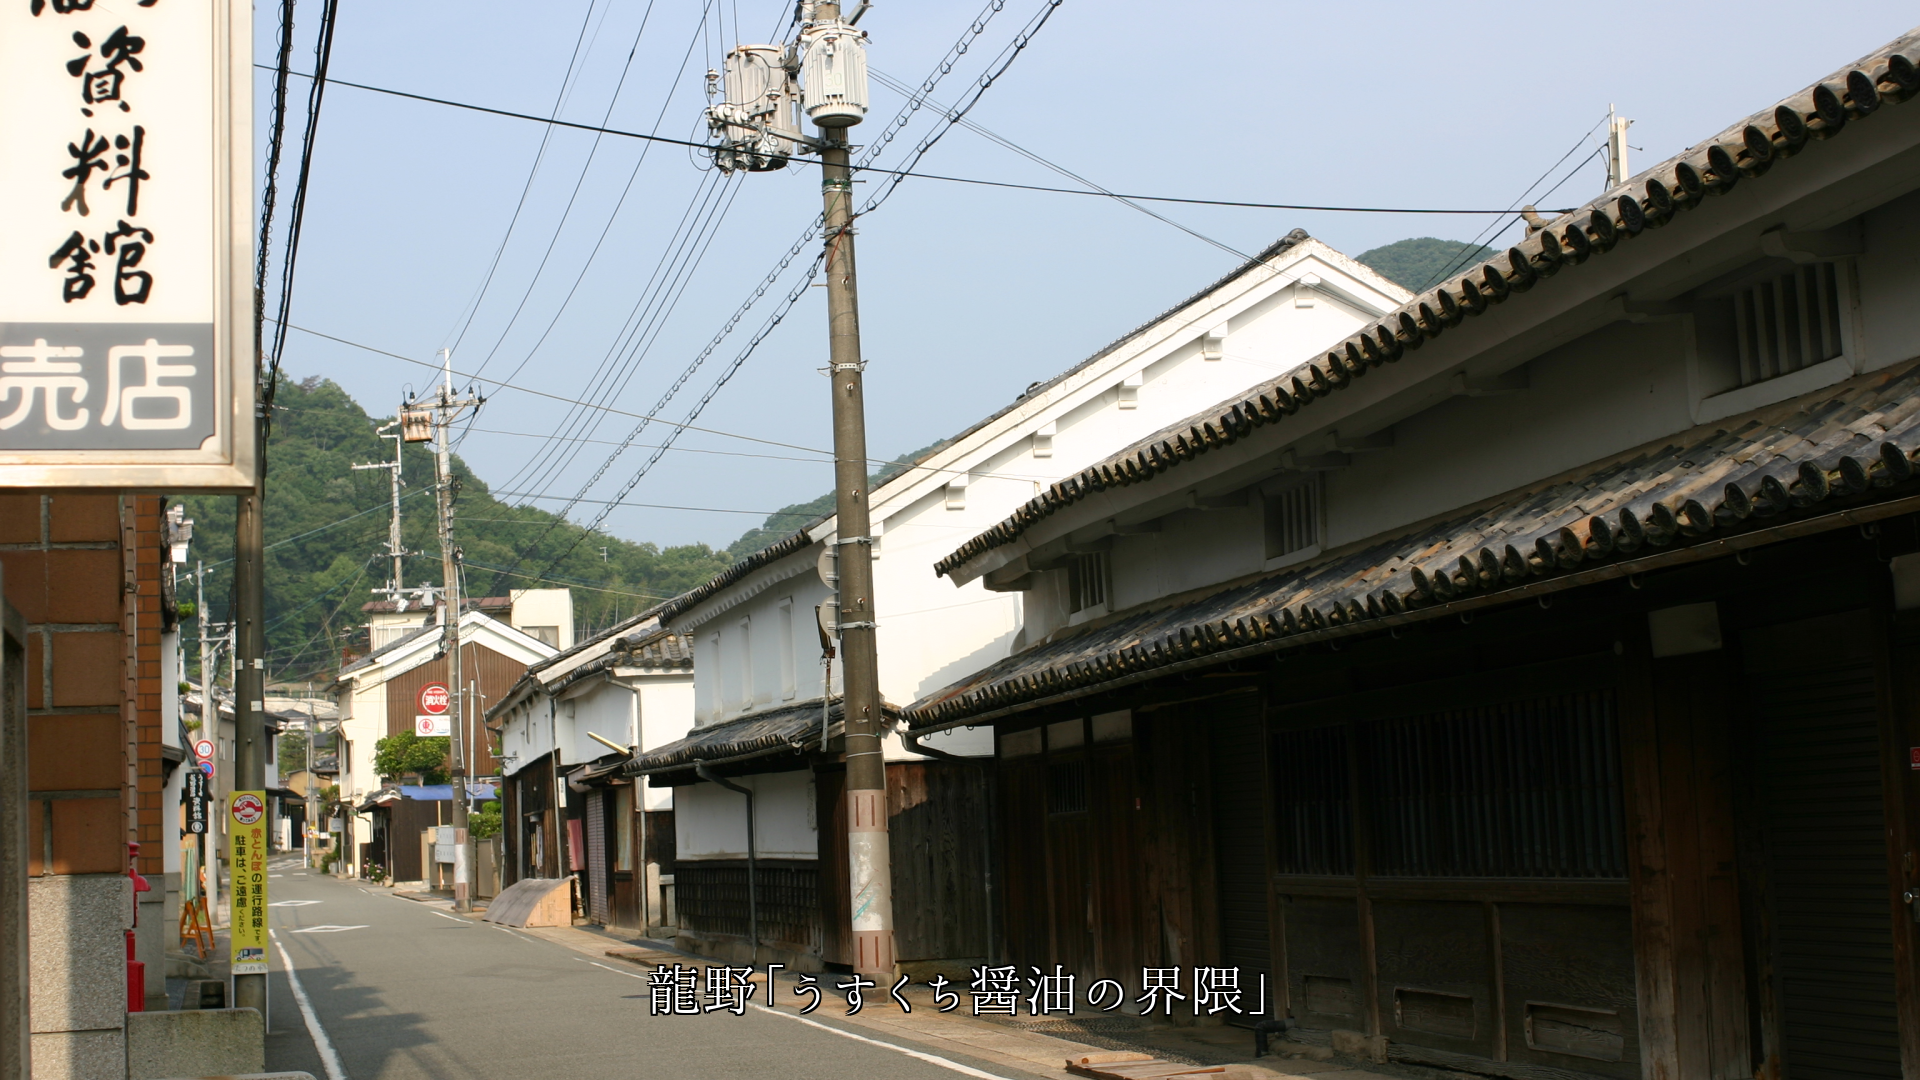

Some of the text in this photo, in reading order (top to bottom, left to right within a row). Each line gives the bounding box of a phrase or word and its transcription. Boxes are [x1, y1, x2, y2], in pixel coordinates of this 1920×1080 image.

[0, 338, 197, 431] 売店
[425, 695, 448, 706] 消火栓
[199, 745, 210, 754] 30
